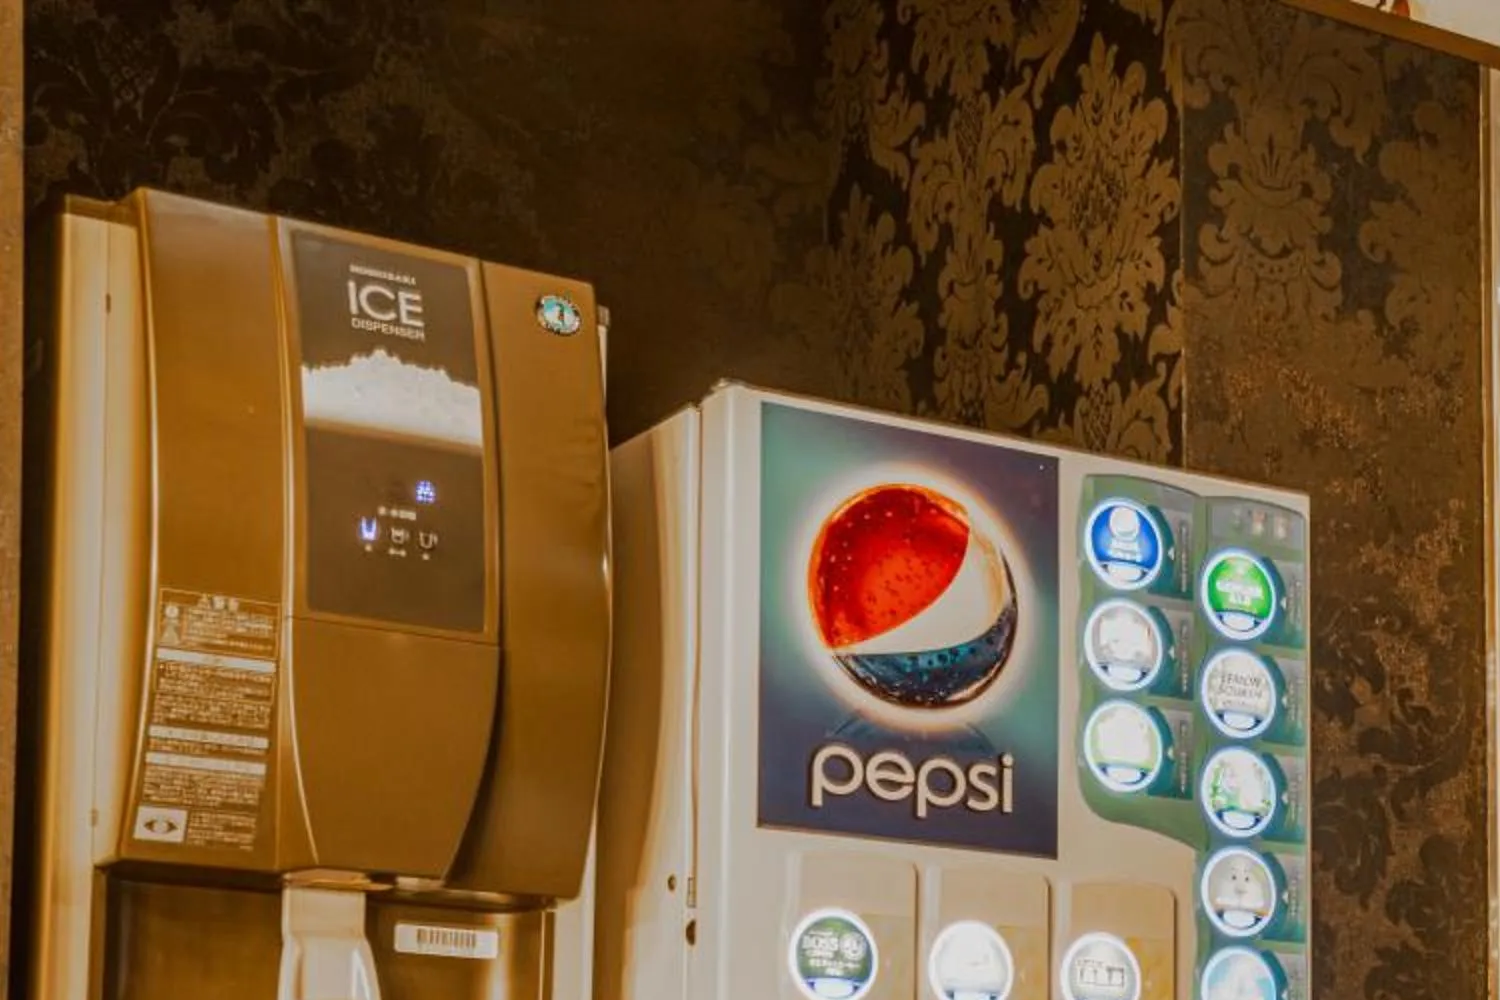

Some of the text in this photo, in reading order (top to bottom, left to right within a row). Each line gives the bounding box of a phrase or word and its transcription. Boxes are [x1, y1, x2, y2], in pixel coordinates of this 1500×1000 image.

[347, 280, 424, 327] ICE
[351, 317, 425, 341] DISPENSER
[810, 742, 1015, 819] pepsi
